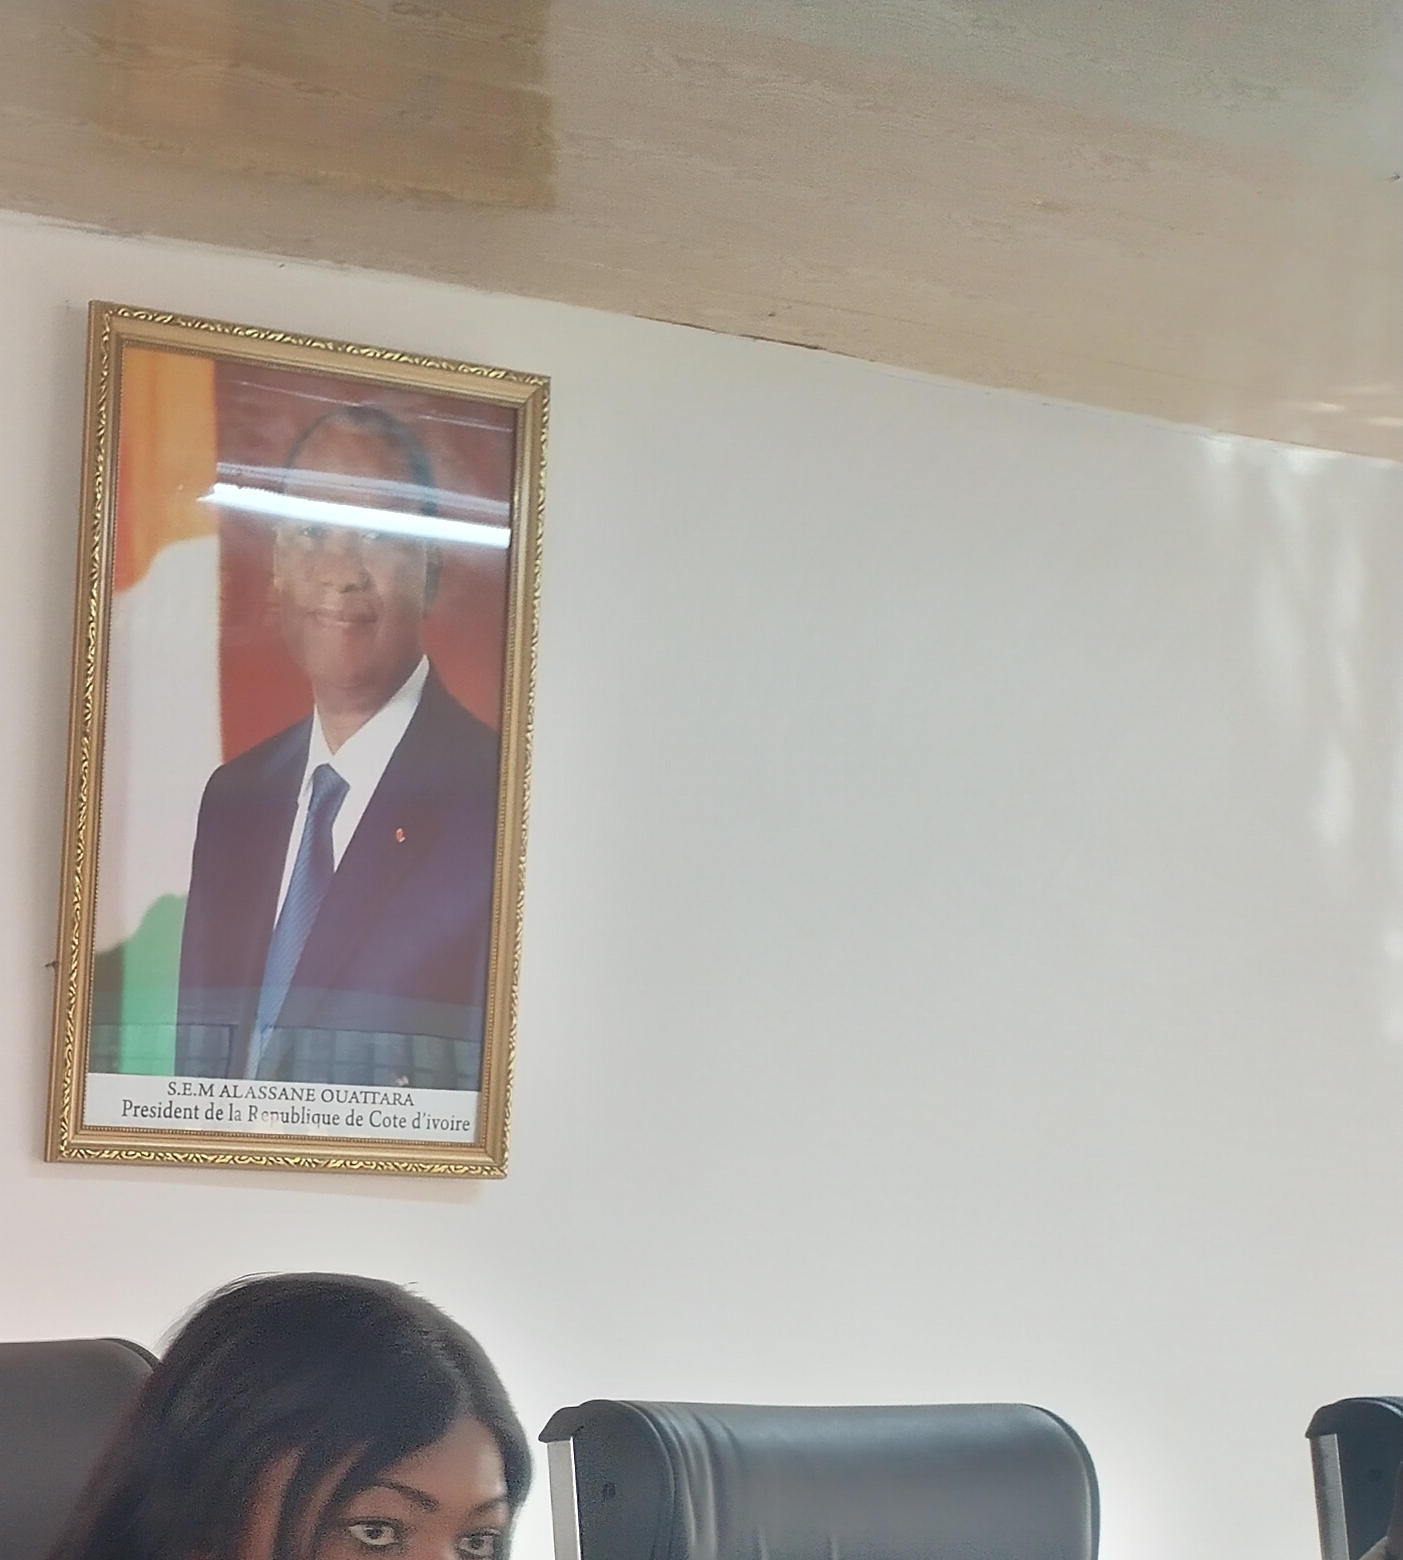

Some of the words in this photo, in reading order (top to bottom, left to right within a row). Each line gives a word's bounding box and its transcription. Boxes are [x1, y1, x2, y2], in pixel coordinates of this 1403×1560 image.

[167, 1081, 215, 1098] S.E.M
[217, 1083, 316, 1102] ALASSANE
[321, 1088, 415, 1107] OUATTARA
[121, 1099, 200, 1121] President
[204, 1104, 225, 1122] de
[228, 1105, 242, 1122] la
[344, 1109, 365, 1128] de
[368, 1110, 407, 1130] Cote
[410, 1112, 471, 1132] d'ivoire
